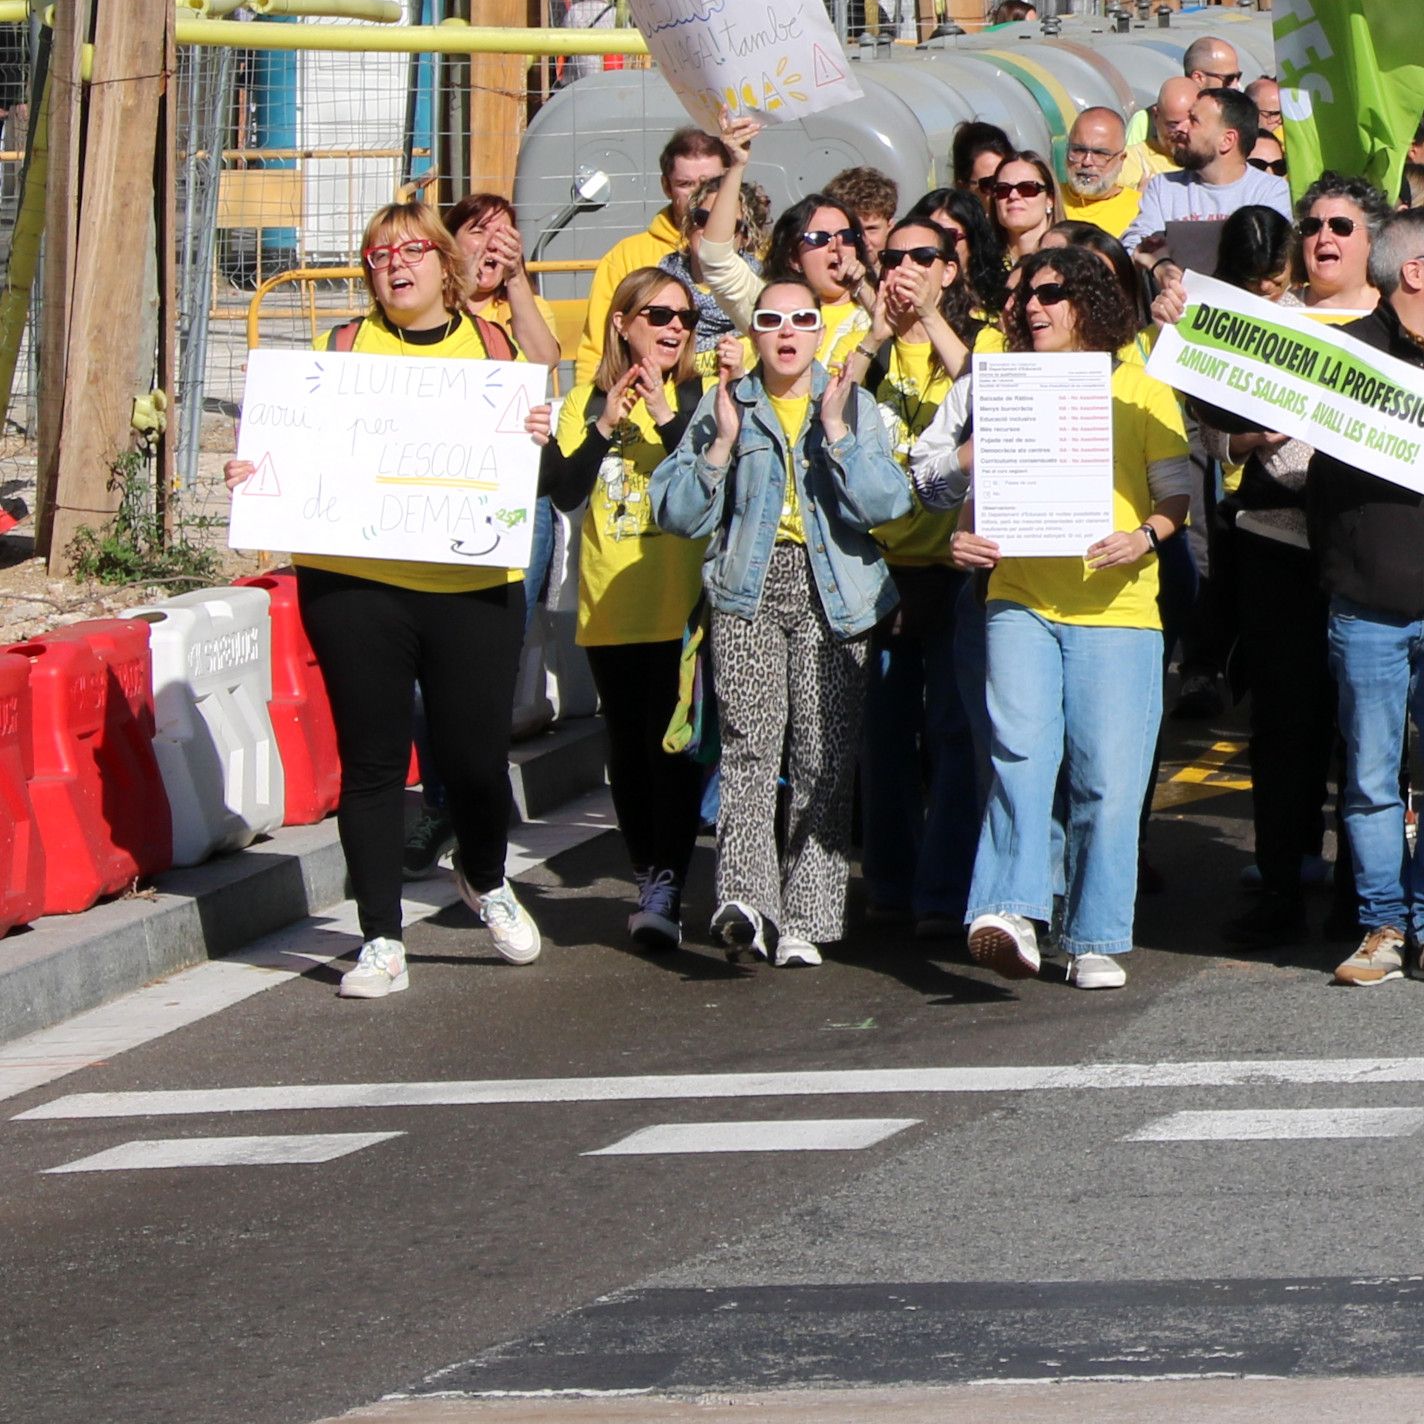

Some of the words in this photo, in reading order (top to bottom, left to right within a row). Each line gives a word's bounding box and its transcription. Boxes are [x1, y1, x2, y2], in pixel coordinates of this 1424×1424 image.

[720, 4, 807, 58] també
[1191, 303, 1321, 378] DIGNIFIQUEM
[1318, 355, 1345, 394] LA
[337, 362, 469, 400] LLUITEM
[1176, 344, 1231, 383] AMUNT
[1226, 366, 1253, 393] ELS
[1251, 375, 1310, 422] SALARIS,
[1310, 401, 1347, 436] AVALL
[1343, 416, 1367, 443] LES
[1365, 425, 1422, 466] RÀTIOS!
[346, 416, 399, 457] per
[377, 442, 499, 480] L'ESCOLA
[302, 472, 342, 523] de
